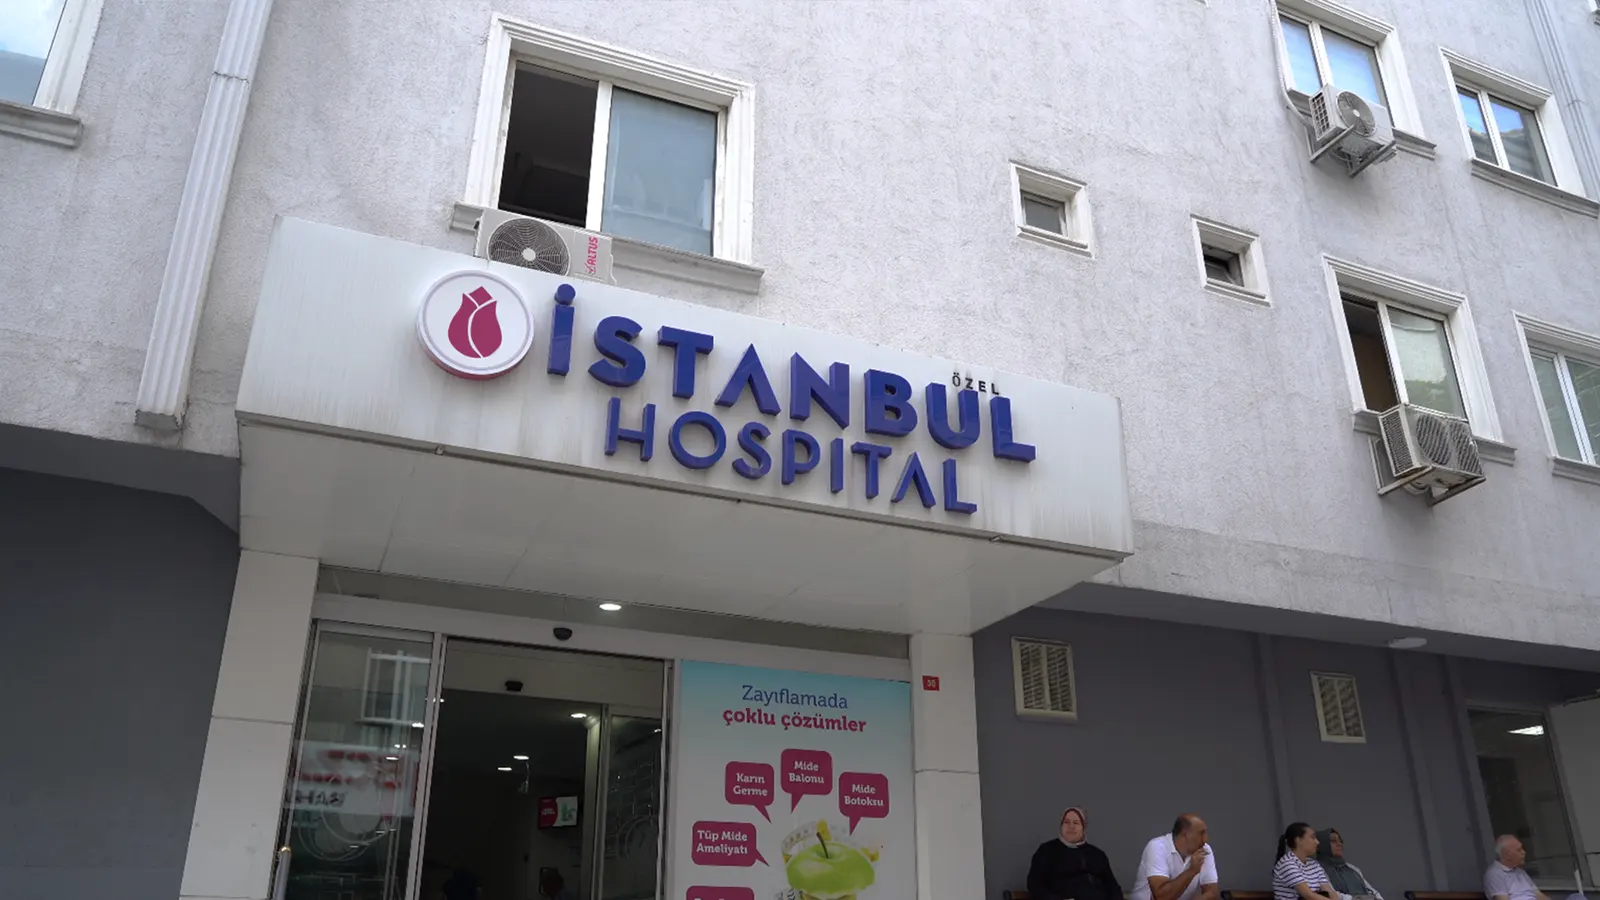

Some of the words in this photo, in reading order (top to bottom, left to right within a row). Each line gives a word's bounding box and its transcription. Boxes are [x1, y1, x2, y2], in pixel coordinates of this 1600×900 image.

[587, 235, 599, 266] ALTUS
[546, 283, 1036, 463] İSTANBUL
[952, 371, 1000, 395] ÖZEL
[604, 396, 977, 515] HOSPITAL
[742, 684, 849, 709] Zayıflamada
[722, 707, 776, 727] çoklu
[780, 711, 867, 732] çözümler
[794, 760, 819, 772] Mide
[736, 772, 765, 784] Karın
[788, 772, 825, 784] Balonu
[732, 785, 768, 797] Germe
[851, 784, 876, 795] Mide
[844, 796, 884, 807] Botoksu
[697, 830, 719, 842] Tüp
[721, 831, 748, 842] Mide
[696, 843, 748, 856] Ameliyatı
